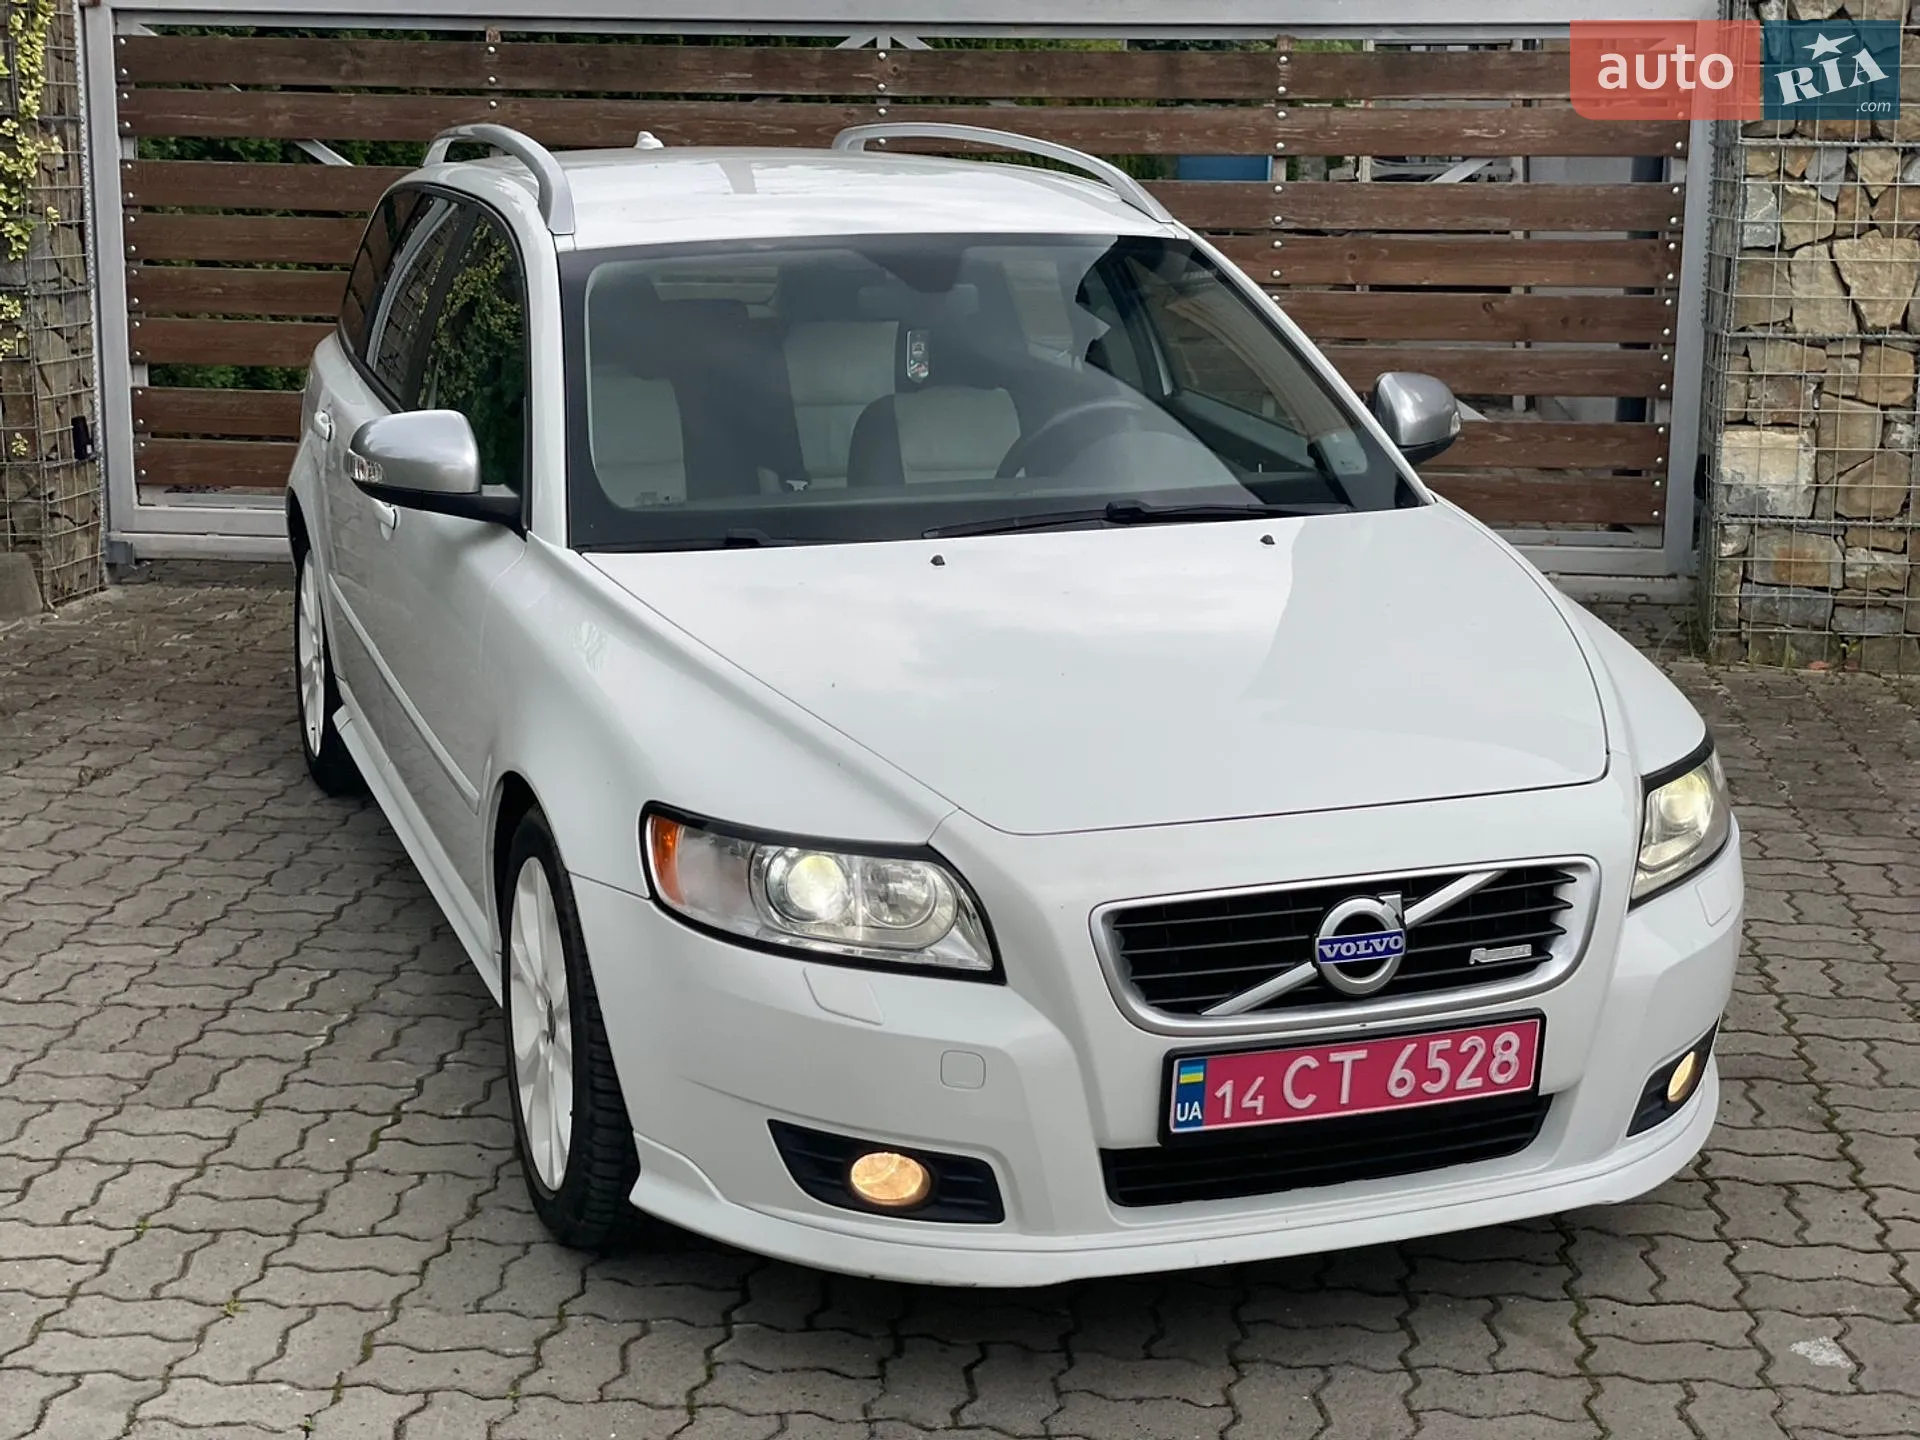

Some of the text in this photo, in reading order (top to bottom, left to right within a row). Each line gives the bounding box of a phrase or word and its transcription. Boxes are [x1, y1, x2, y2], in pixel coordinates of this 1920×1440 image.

[1319, 935, 1404, 959] VOLVO
[1214, 1031, 1521, 1119] 14 CT 6528
[1175, 1101, 1202, 1122] UA
